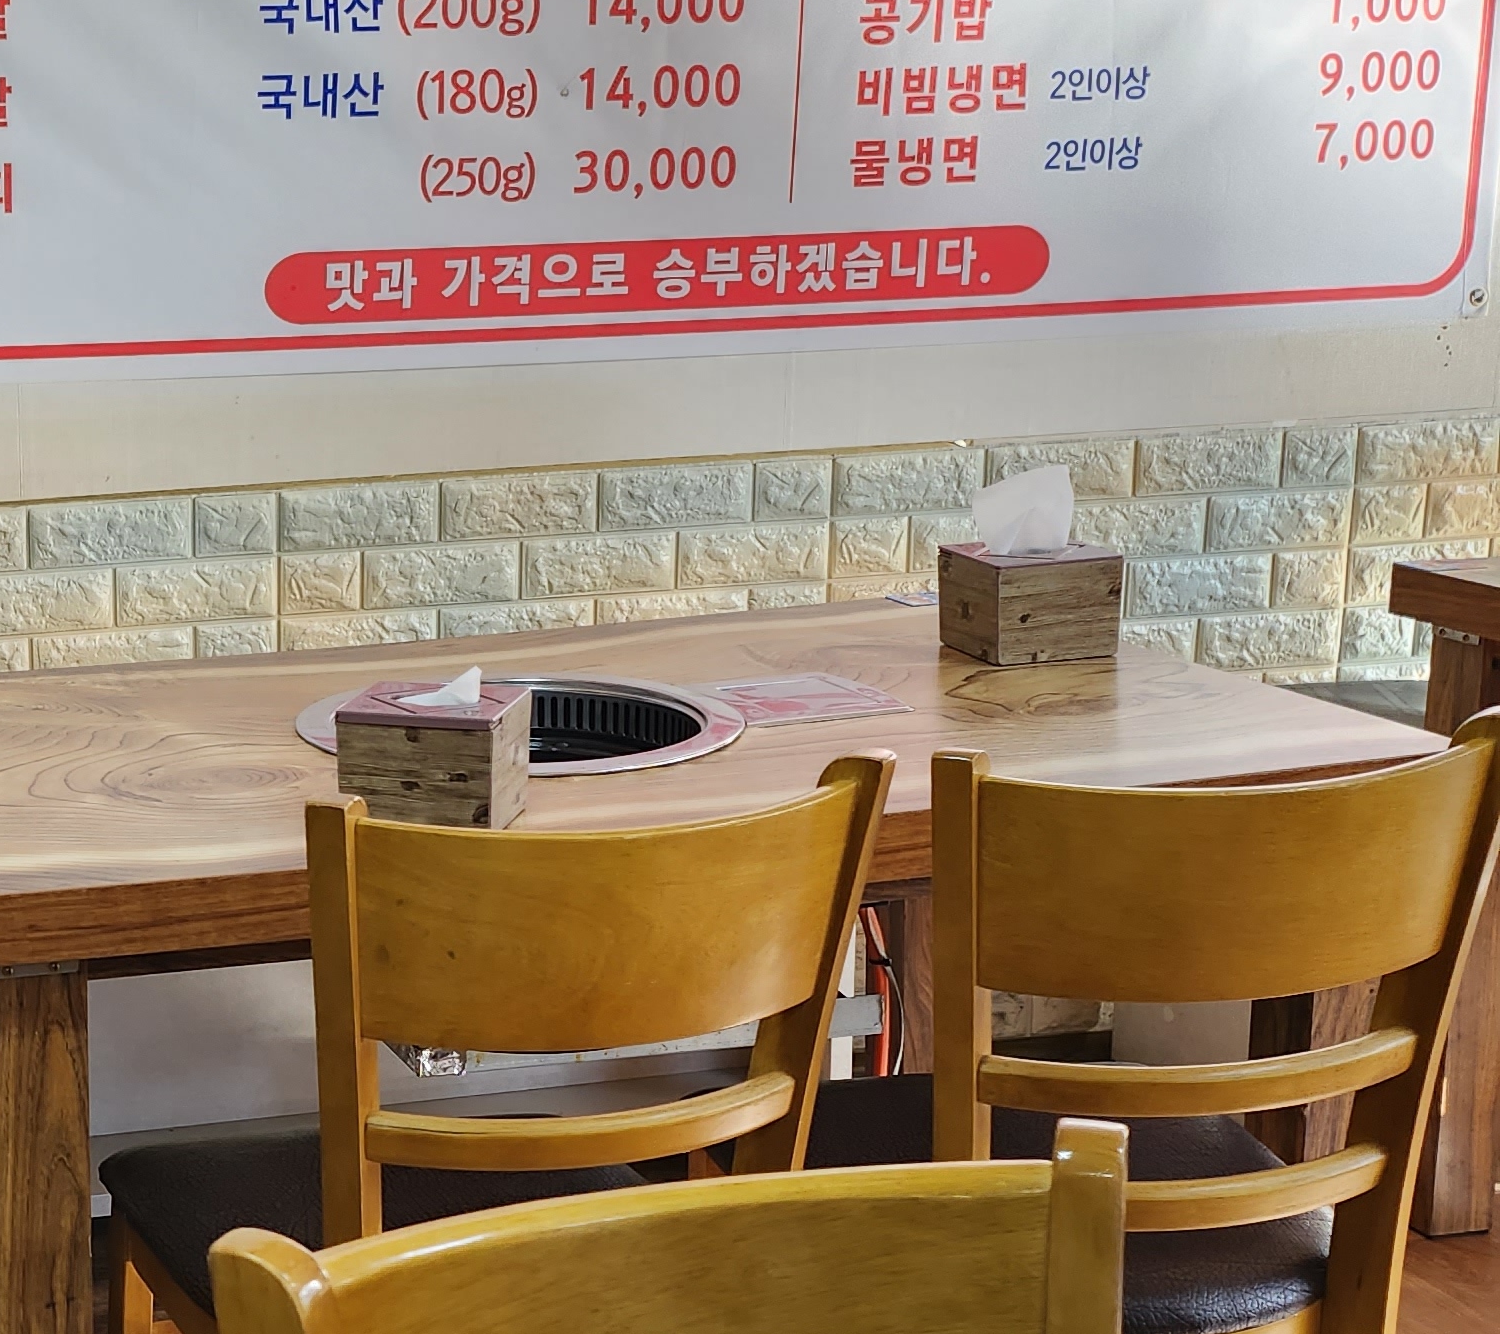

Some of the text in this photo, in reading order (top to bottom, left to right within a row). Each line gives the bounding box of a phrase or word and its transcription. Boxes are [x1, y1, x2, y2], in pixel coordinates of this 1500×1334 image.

[257, 71, 385, 120] 국내산
[416, 68, 538, 120] (180g)
[578, 63, 742, 116] 14,000
[856, 49, 1441, 117] 비빔냉면 2인이상 9,000
[419, 151, 536, 202] (250g)
[573, 145, 737, 197] 30,000
[849, 118, 1435, 188] 물냉면 2인이상 7,000
[325, 236, 991, 312] 맛과 가격으로 승부하겠습니다.
